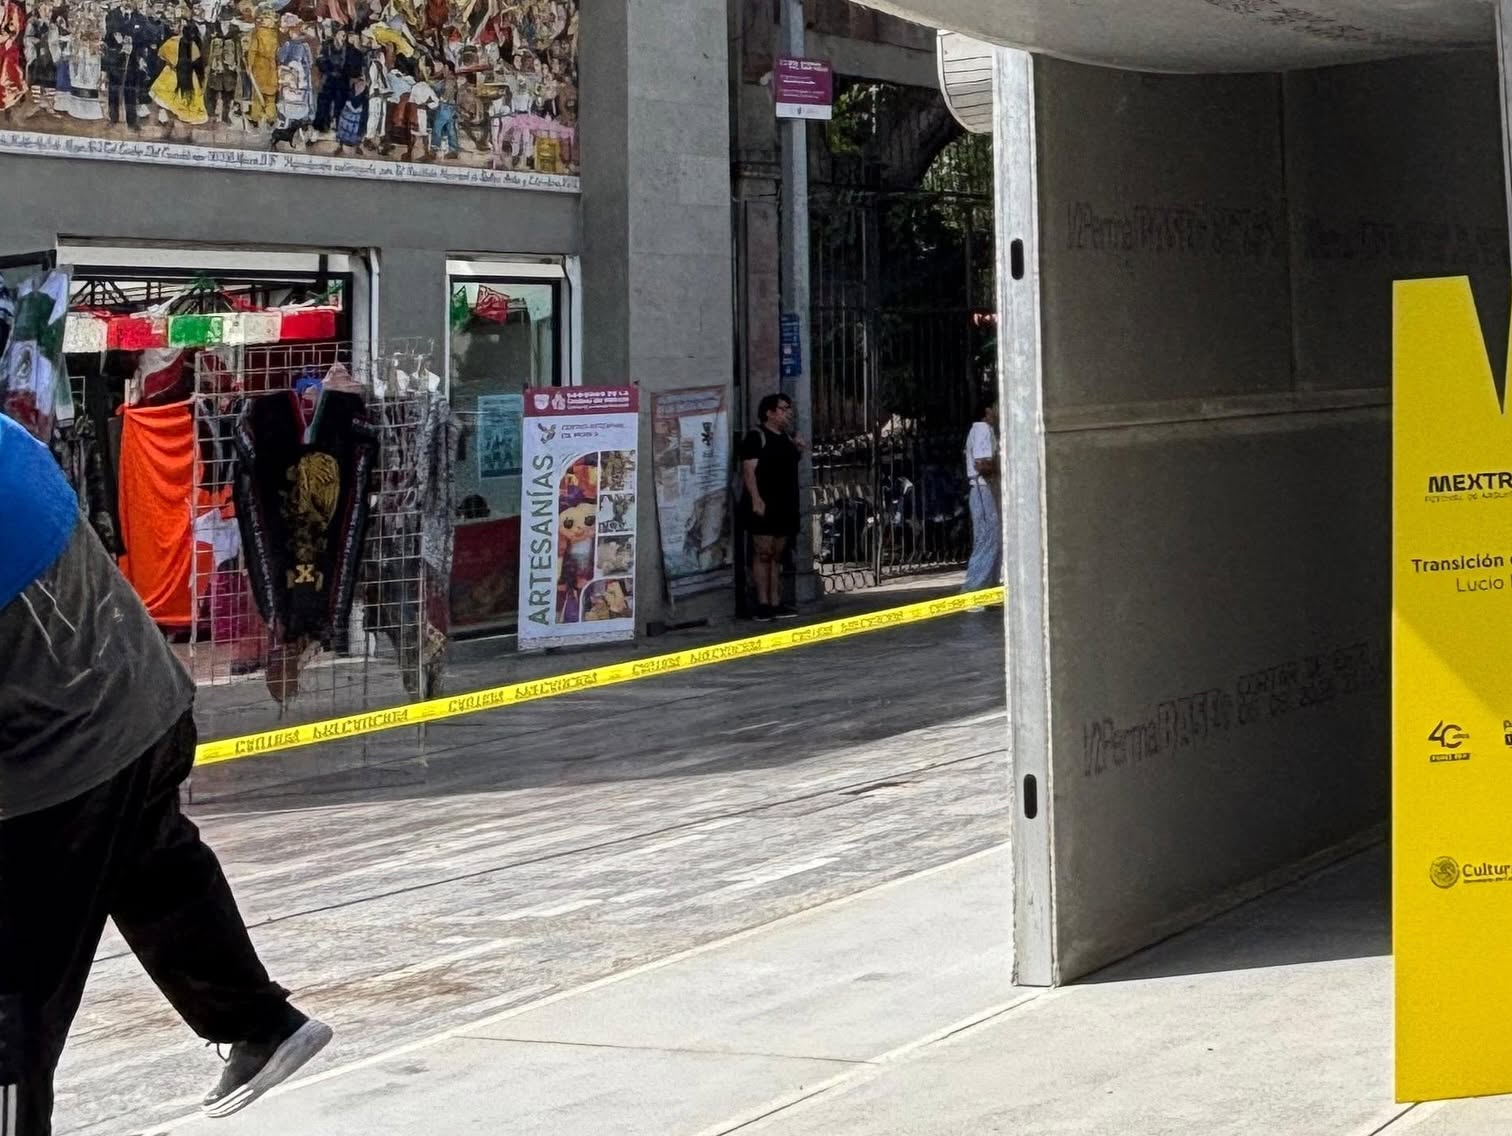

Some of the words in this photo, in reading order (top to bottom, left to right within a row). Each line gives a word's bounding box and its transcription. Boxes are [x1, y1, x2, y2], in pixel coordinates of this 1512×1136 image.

[527, 453, 555, 626] ARTESANÍAS
[1411, 552, 1504, 573] Transición
[1456, 576, 1505, 593] Lucio
